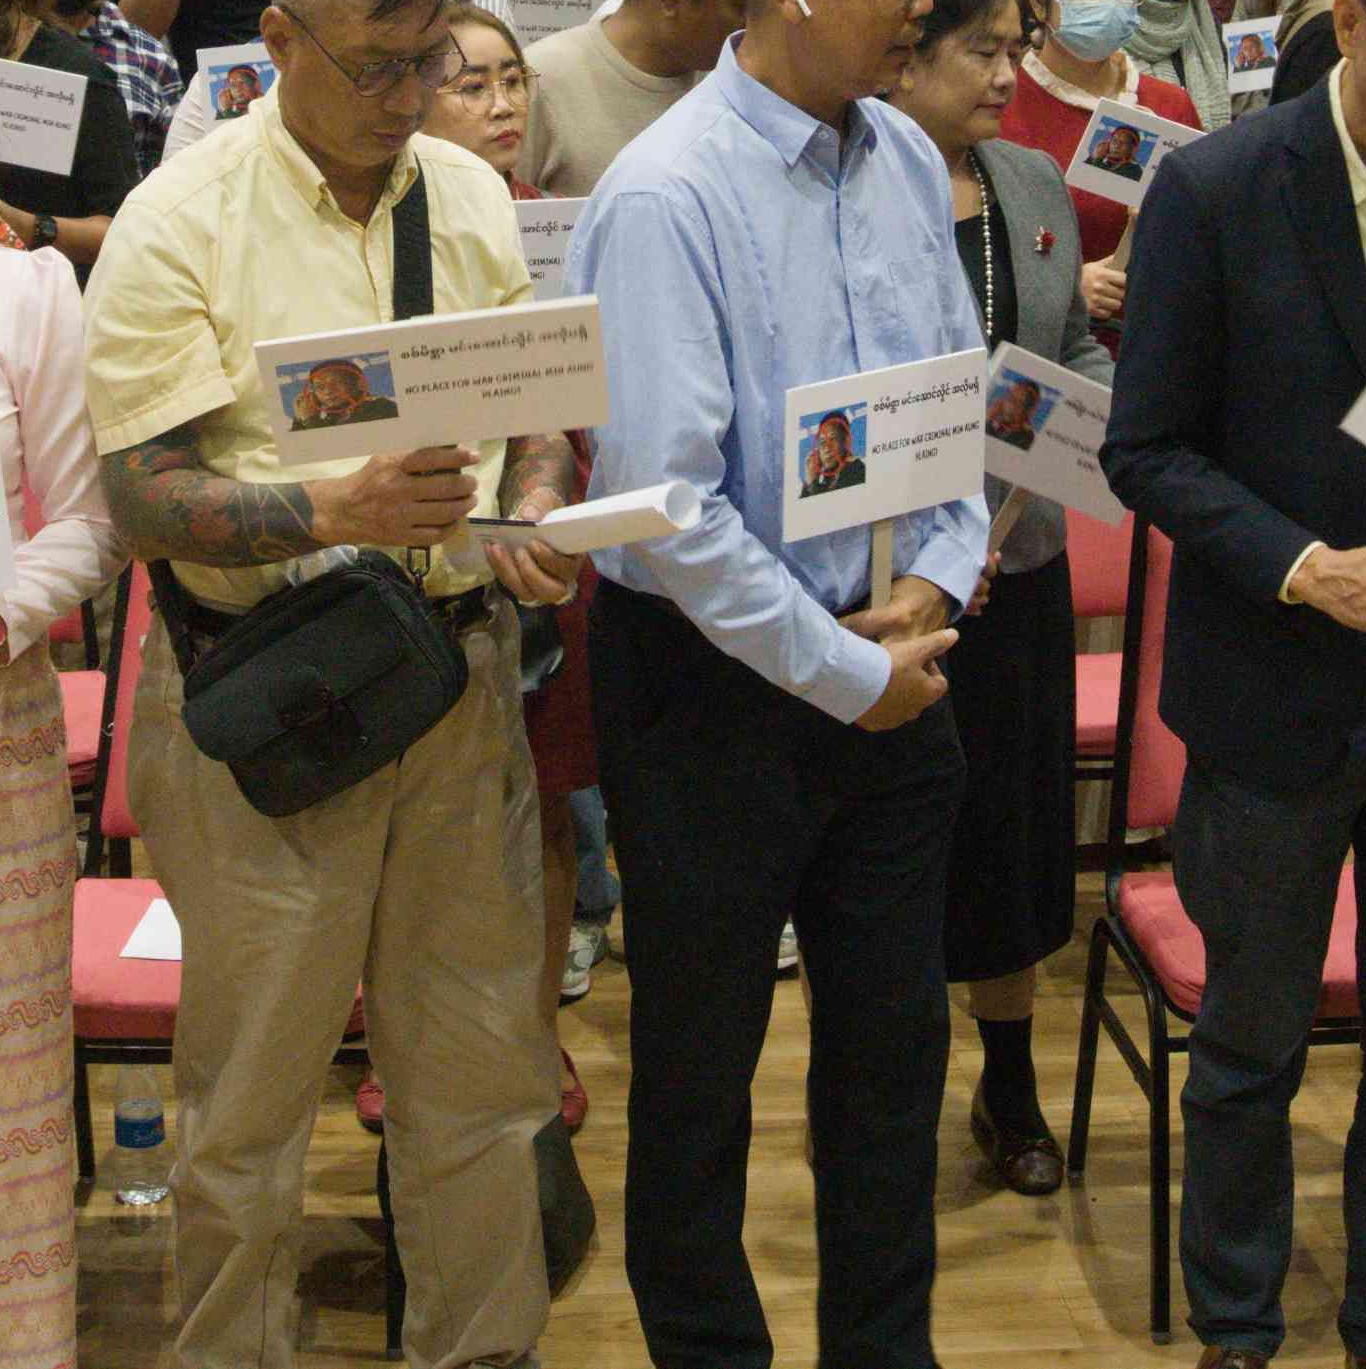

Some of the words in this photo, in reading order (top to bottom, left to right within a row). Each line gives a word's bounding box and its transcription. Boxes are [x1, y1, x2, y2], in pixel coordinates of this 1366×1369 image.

[871, 444, 880, 454] NO
[882, 439, 898, 452] PLACE
[899, 437, 909, 448] FOR
[911, 434, 923, 445] WAR
[924, 427, 950, 442] CRIMINAL
[952, 424, 962, 435] MIN
[964, 420, 978, 432] AUNG
